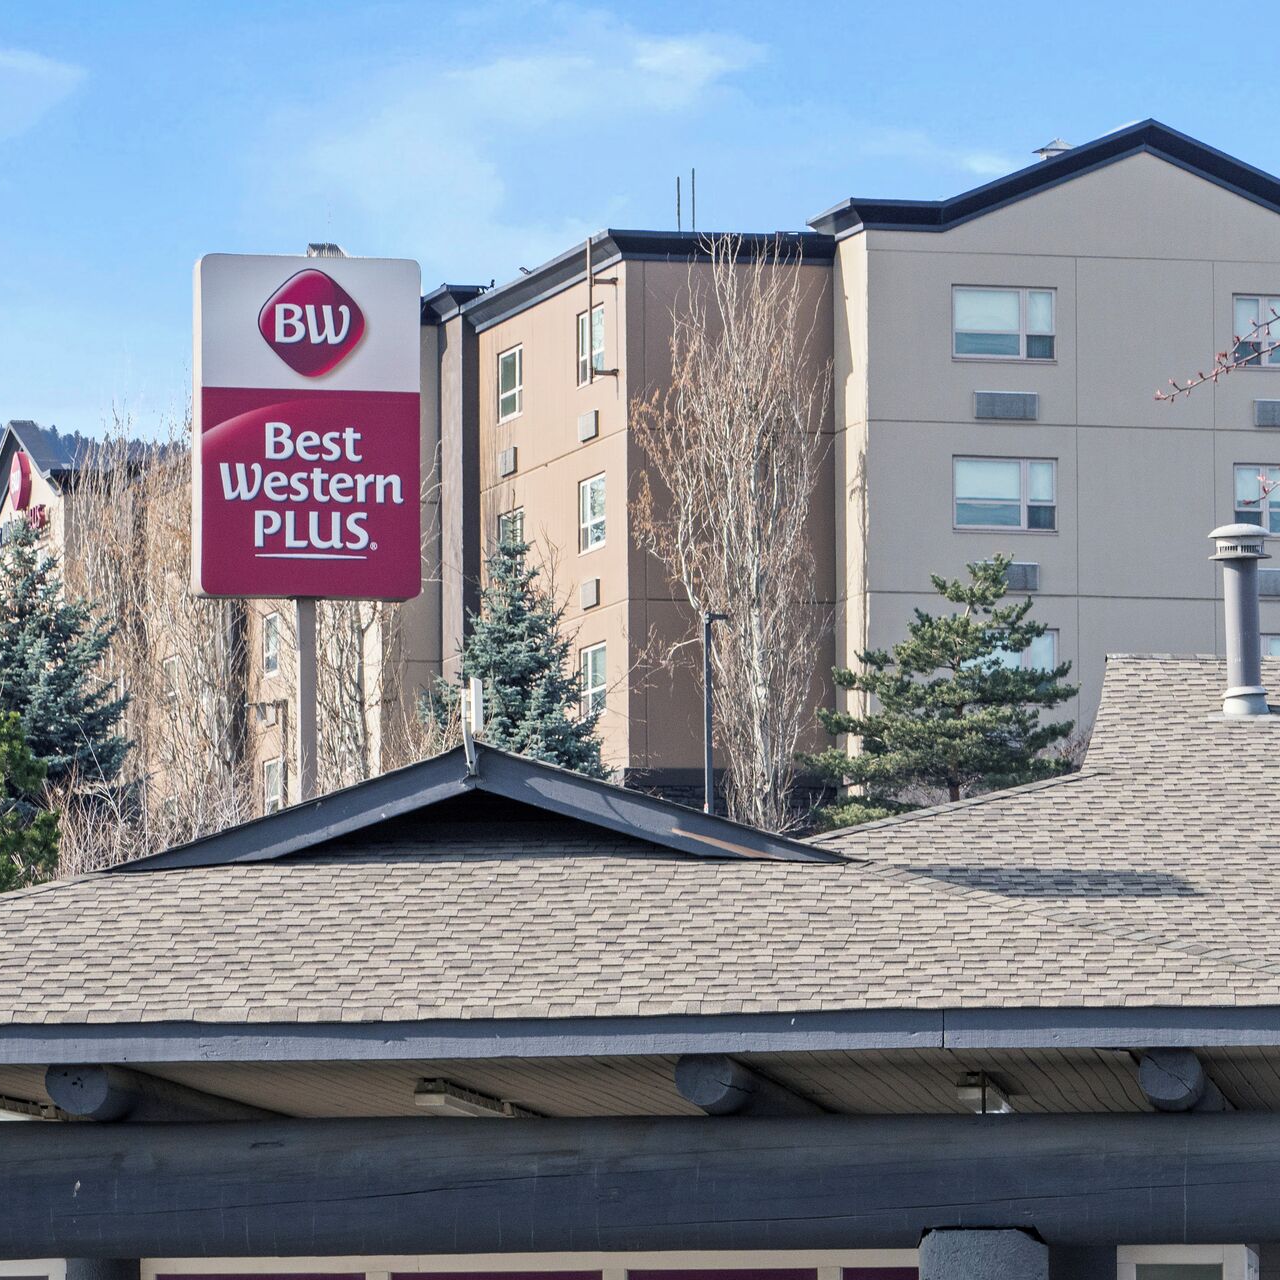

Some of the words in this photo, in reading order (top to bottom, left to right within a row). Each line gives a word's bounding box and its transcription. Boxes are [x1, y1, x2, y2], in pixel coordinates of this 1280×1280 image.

[275, 303, 351, 345] BW
[265, 422, 362, 462] Best
[219, 463, 404, 504] Western
